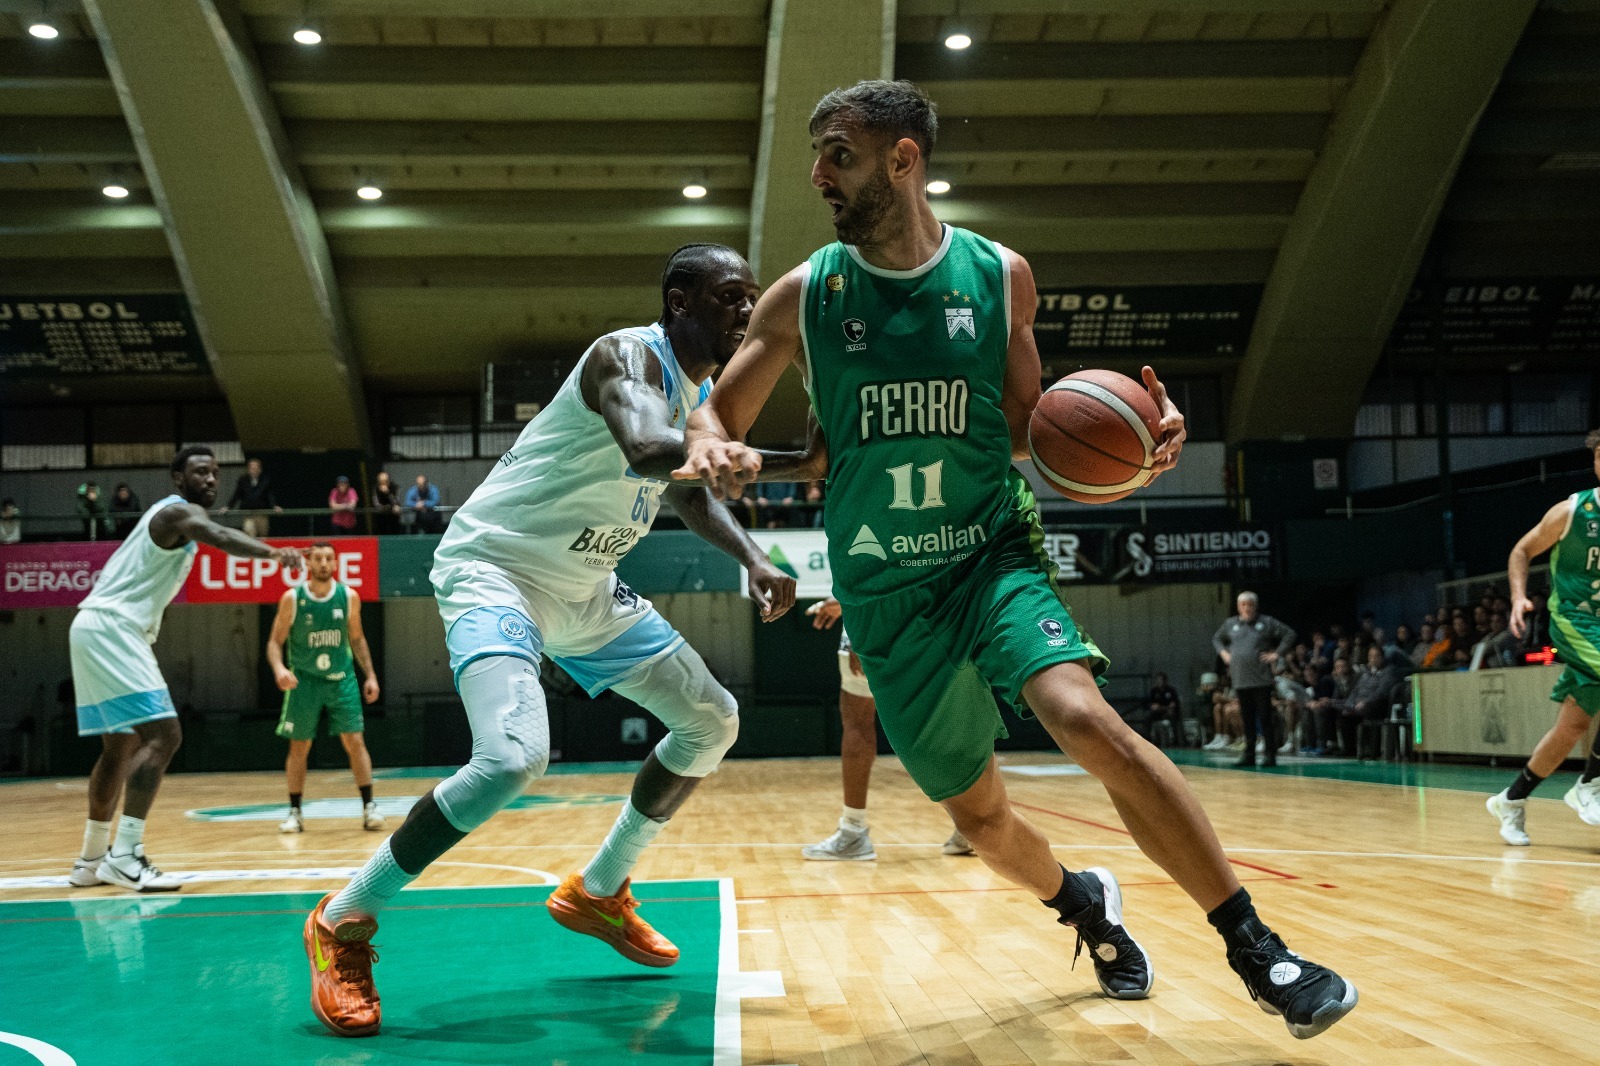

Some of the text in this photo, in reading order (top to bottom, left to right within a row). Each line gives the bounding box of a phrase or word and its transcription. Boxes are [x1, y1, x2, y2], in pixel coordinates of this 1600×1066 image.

[1036, 294, 1131, 311] TBOL
[860, 379, 968, 440] FERRO
[885, 459, 947, 510] 11
[891, 524, 987, 554] avalian
[1154, 530, 1271, 554] SINTIENDO
[201, 552, 363, 589] LEPOE
[900, 556, 949, 568] COBERTURA
[316, 653, 332, 671] 6
